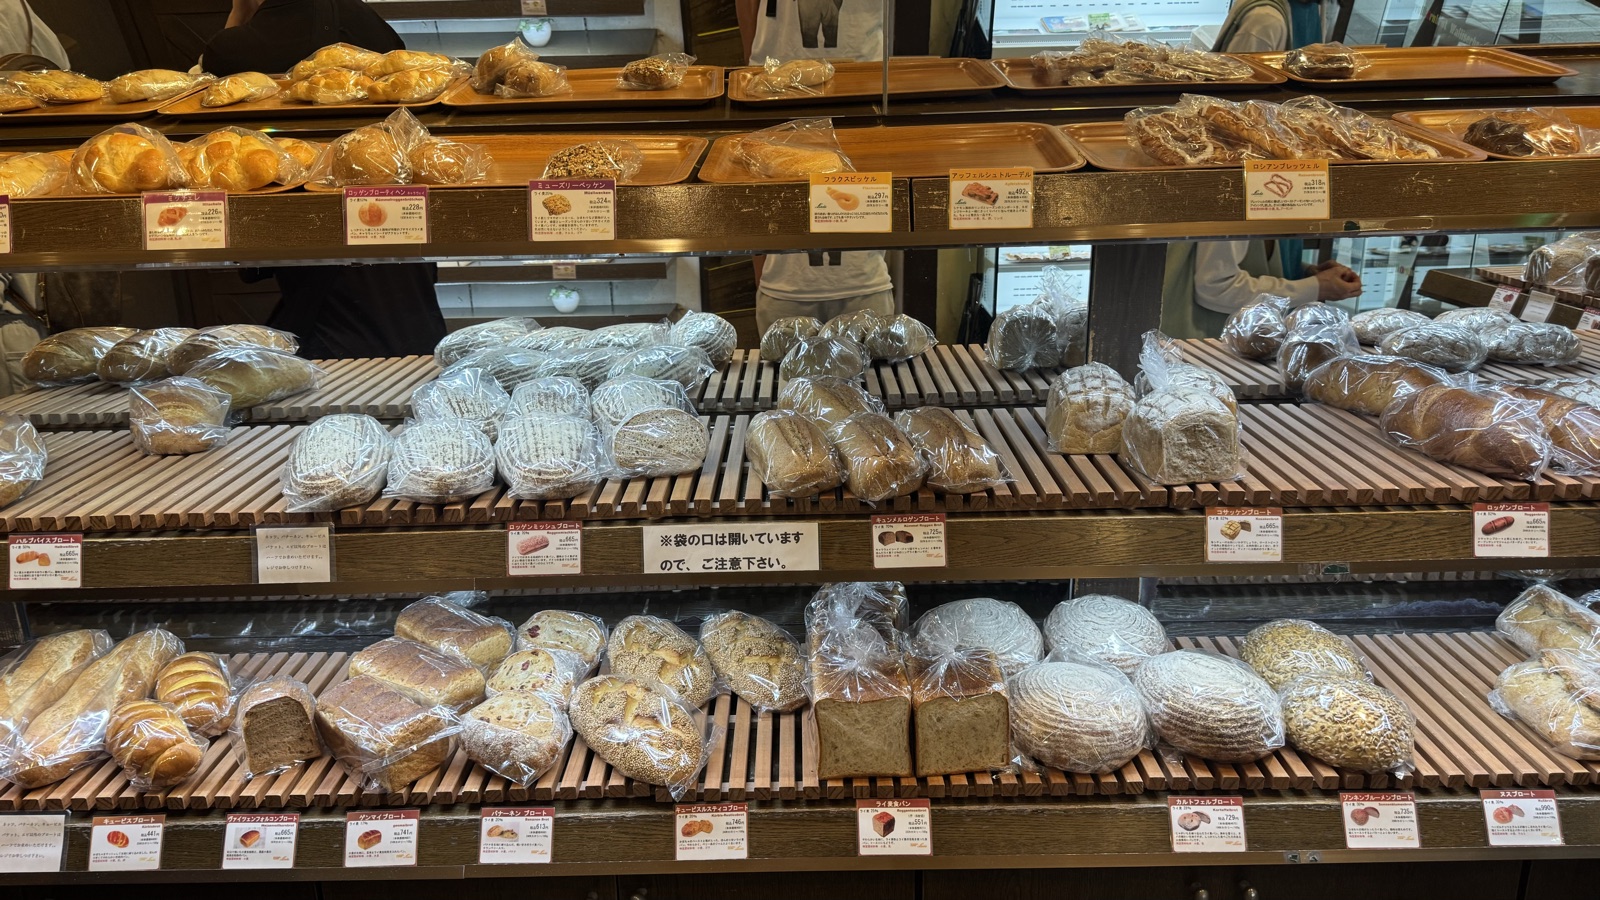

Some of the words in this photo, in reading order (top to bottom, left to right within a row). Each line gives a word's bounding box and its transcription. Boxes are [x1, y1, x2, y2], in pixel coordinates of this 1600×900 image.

[509, 522, 580, 530] ロッゲンミッシュブロート
[659, 531, 804, 547] ※袋の口は開いています
[659, 556, 787, 572] ので、ご注意下さい。
[359, 813, 406, 821] ゲンマイブロート
